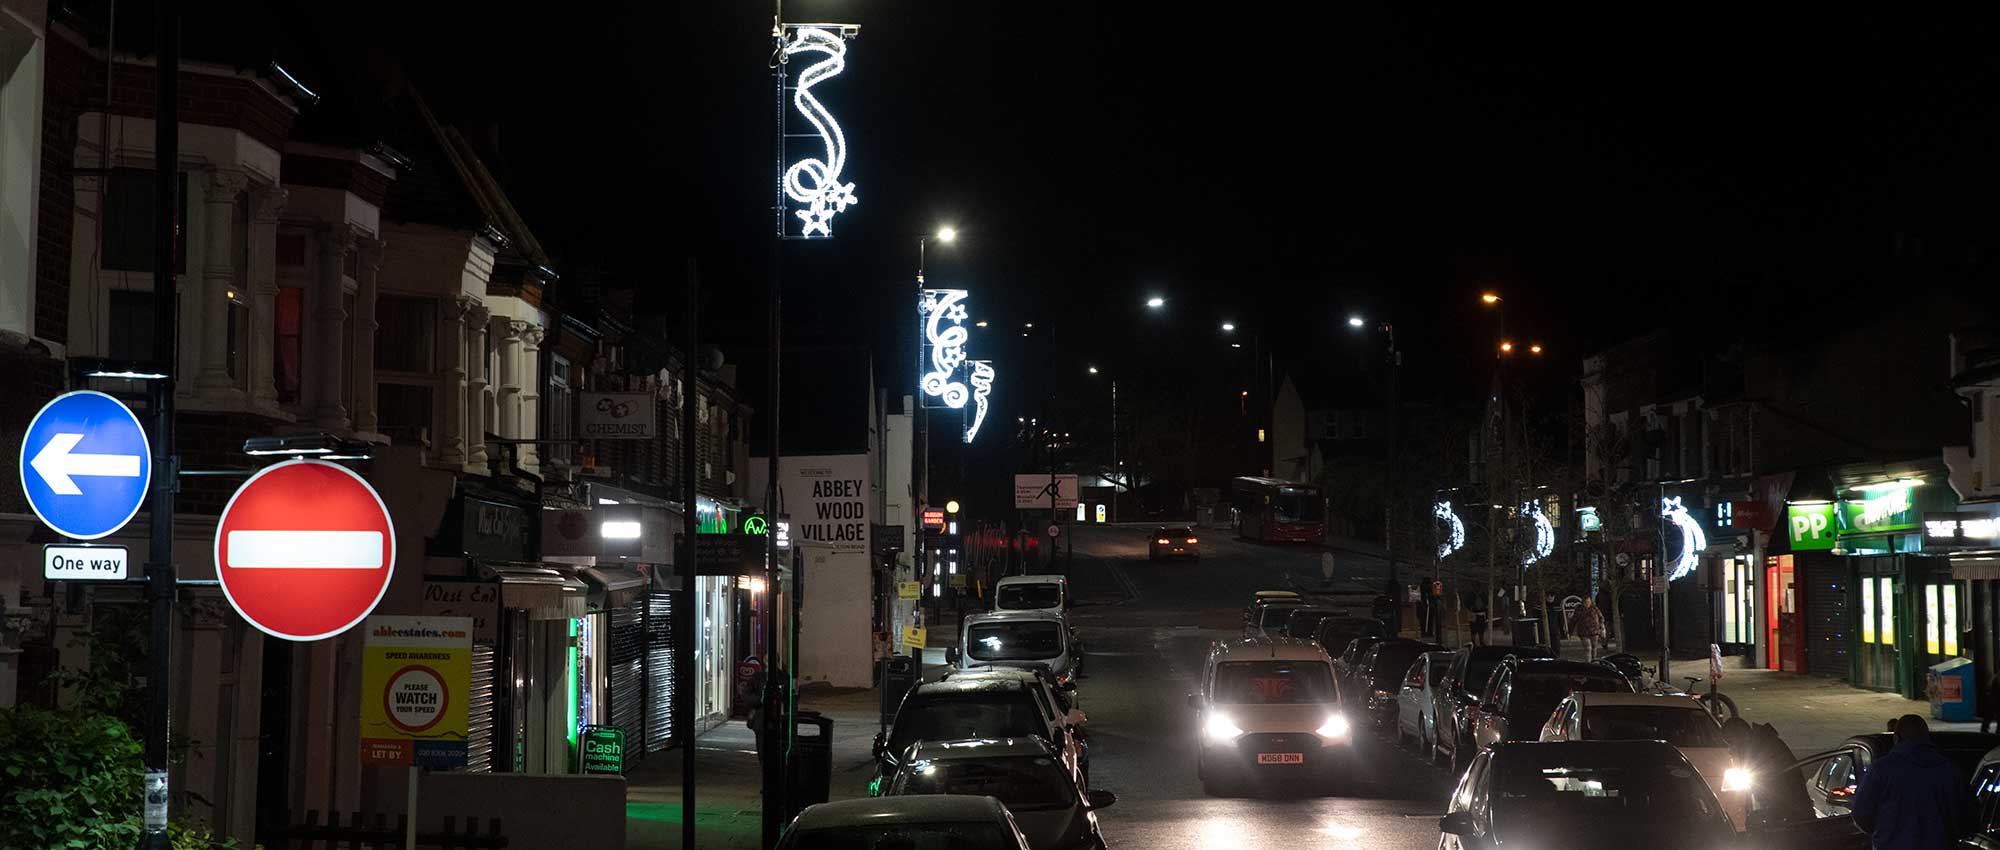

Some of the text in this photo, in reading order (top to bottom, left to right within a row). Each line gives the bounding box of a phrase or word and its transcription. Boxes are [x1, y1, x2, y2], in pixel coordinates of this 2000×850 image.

[586, 423, 647, 435] CHEMIST
[812, 479, 863, 498] ABBEY
[816, 502, 864, 520] WOOD
[801, 523, 865, 541] VILLAGE
[52, 555, 121, 573] One way
[424, 584, 497, 603] West End
[395, 692, 437, 705] WATCH
[586, 740, 620, 754] Cash
[371, 750, 402, 759] LET BY
[585, 752, 619, 762] machine
[585, 762, 619, 772] Available
